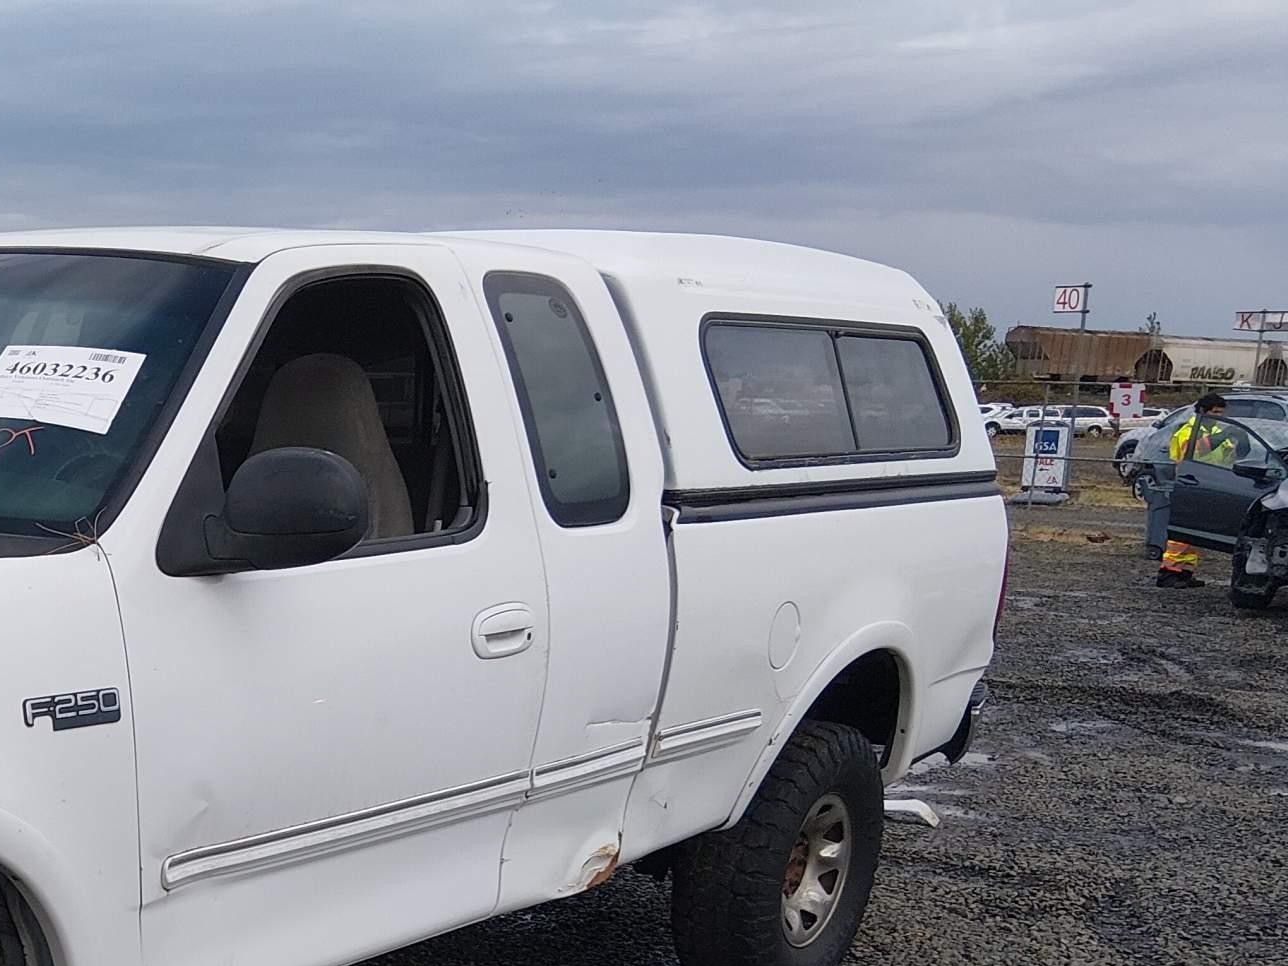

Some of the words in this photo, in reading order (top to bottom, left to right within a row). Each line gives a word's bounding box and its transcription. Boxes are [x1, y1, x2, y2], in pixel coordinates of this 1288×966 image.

[1056, 288, 1080, 310] 40
[1239, 313, 1254, 329] K
[6, 361, 119, 383] 46032236
[1121, 393, 1132, 406] 3
[1035, 441, 1057, 451] GSA
[1036, 456, 1054, 466] ALE
